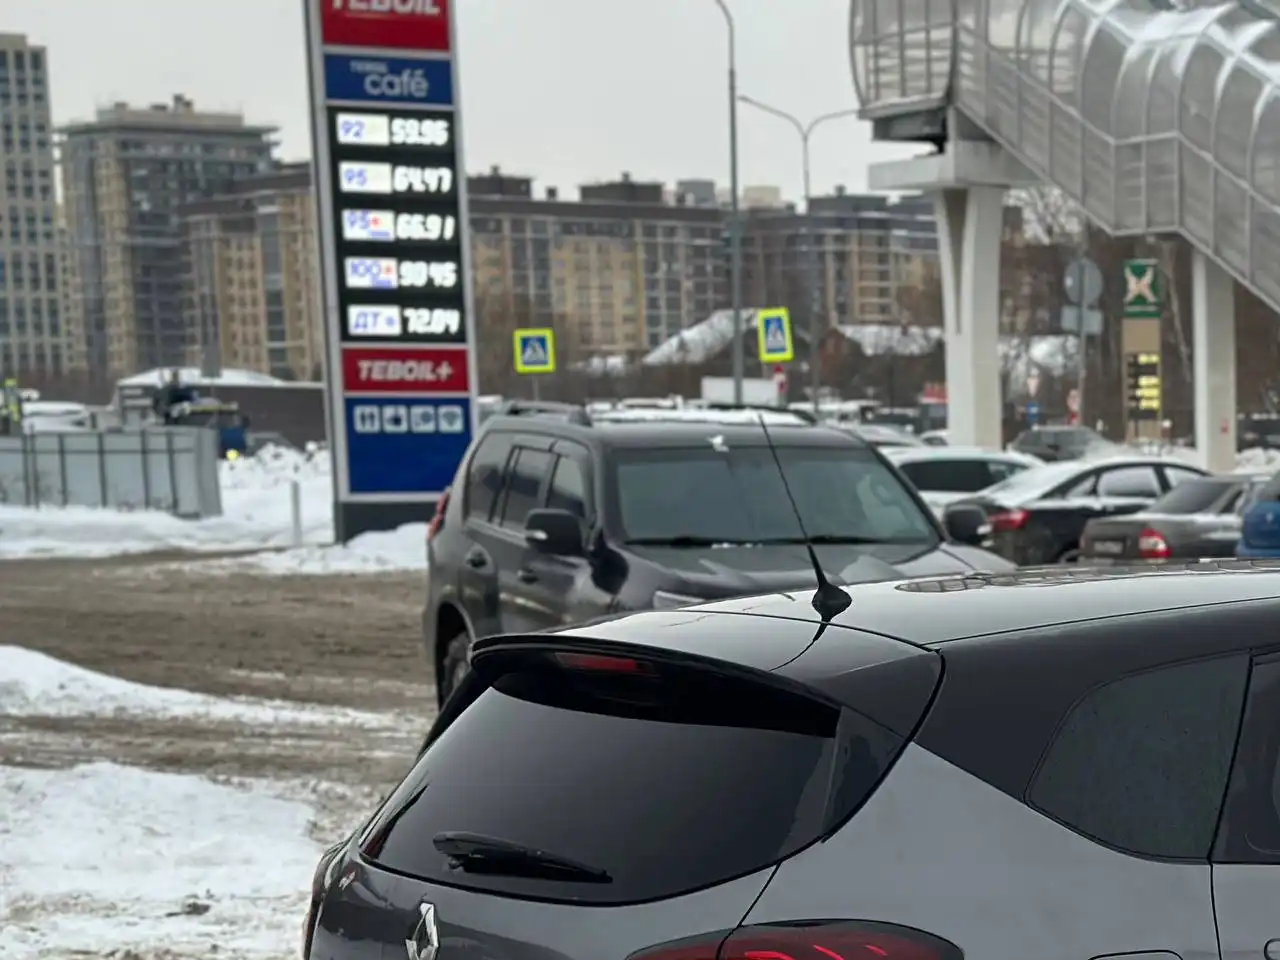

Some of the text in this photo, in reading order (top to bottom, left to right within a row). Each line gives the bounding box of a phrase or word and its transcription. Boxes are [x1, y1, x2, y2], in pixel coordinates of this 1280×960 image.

[363, 68, 429, 98] café
[341, 120, 365, 139] 92
[344, 167, 368, 187] 95
